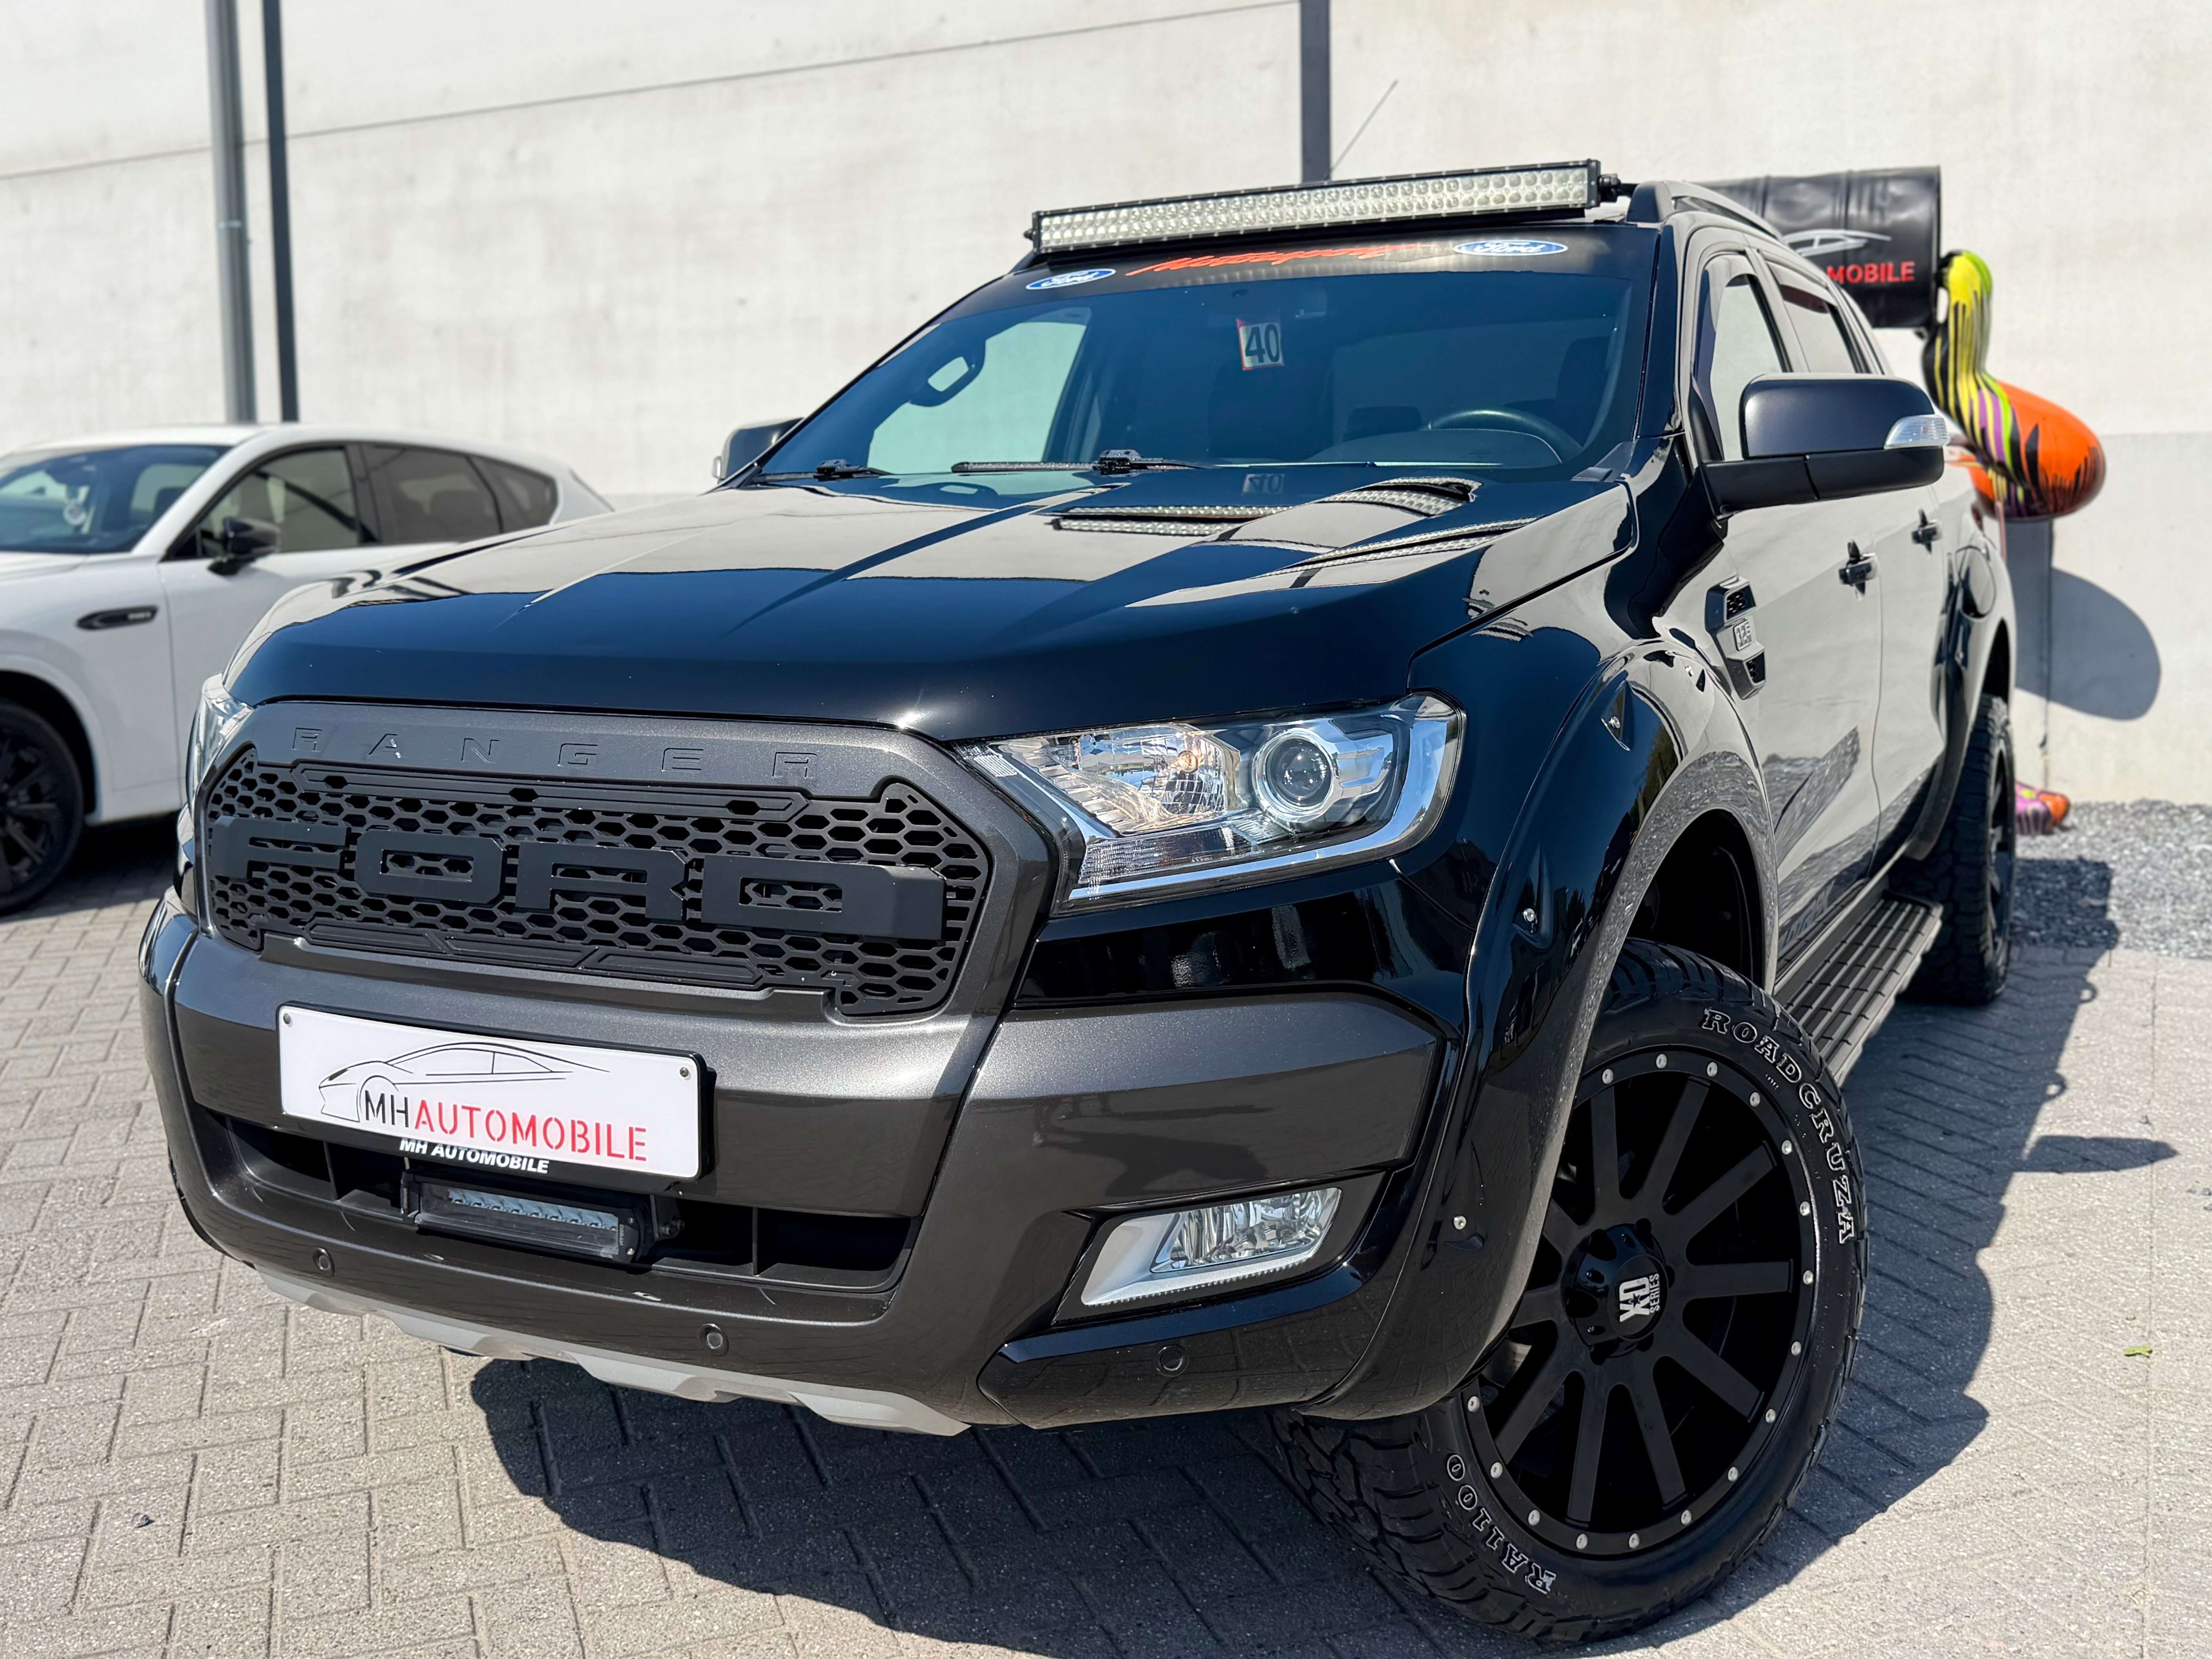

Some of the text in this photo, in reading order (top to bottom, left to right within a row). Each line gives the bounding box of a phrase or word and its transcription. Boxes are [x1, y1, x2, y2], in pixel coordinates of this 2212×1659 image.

[1826, 261, 1915, 285] MOBILE
[1245, 324, 1280, 363] 40
[292, 727, 818, 779] RANGER
[211, 815, 947, 941] FORD
[399, 1138, 550, 1174] MH AUTOMOBILE
[1619, 1277, 1650, 1323] XD
[1649, 1273, 1660, 1313] SERIES
[1446, 1454, 1557, 1594] RA1100
